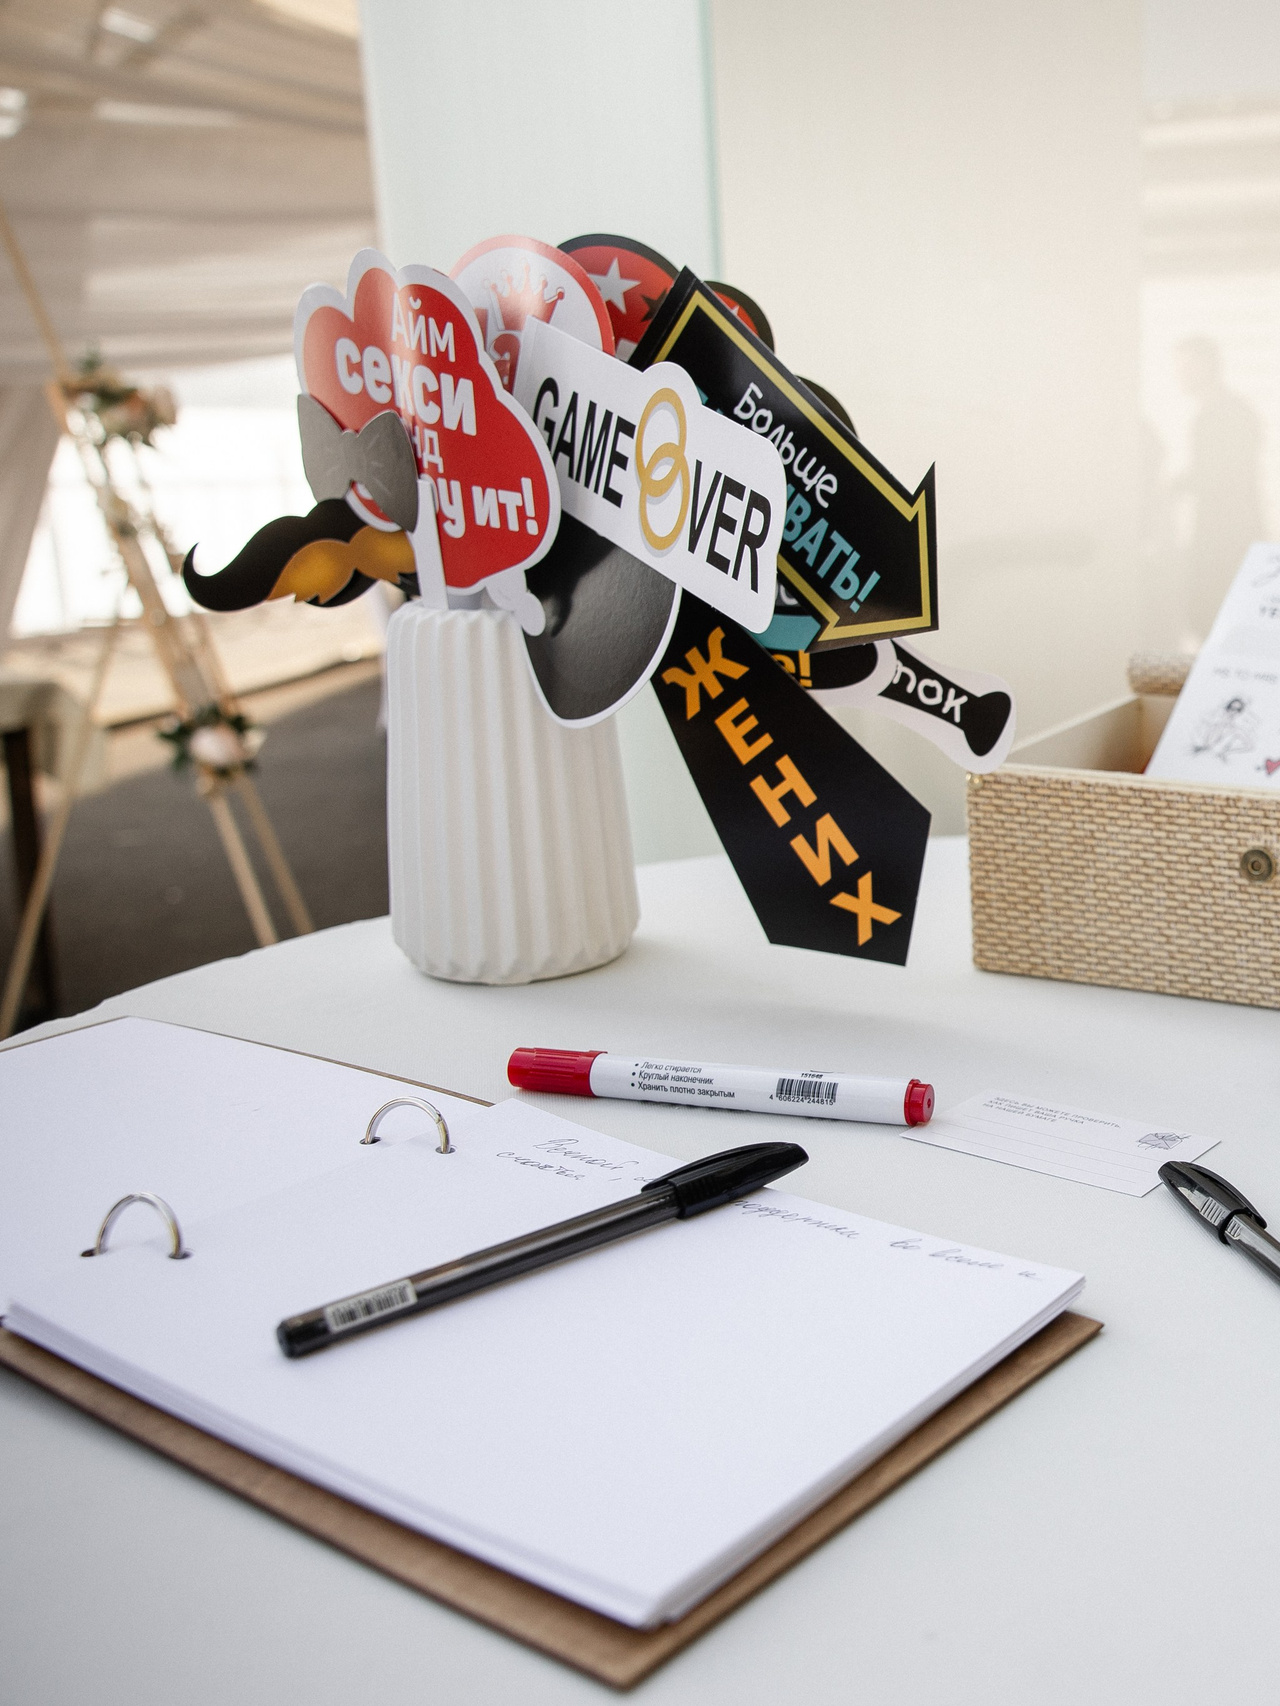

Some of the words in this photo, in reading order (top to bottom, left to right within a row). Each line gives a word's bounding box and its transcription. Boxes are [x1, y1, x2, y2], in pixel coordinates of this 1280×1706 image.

[533, 377, 636, 508] GAME
[471, 476, 539, 536] ит!
[661, 626, 903, 946] ЖЕНИХ
[638, 1070, 670, 1081] Круглый
[670, 1073, 714, 1085] наконечник
[641, 1061, 664, 1071] Легко
[664, 1064, 702, 1074] стирается
[637, 1080, 669, 1092] Хранить
[669, 1085, 696, 1095] плотно
[697, 1087, 736, 1098] закрытым
